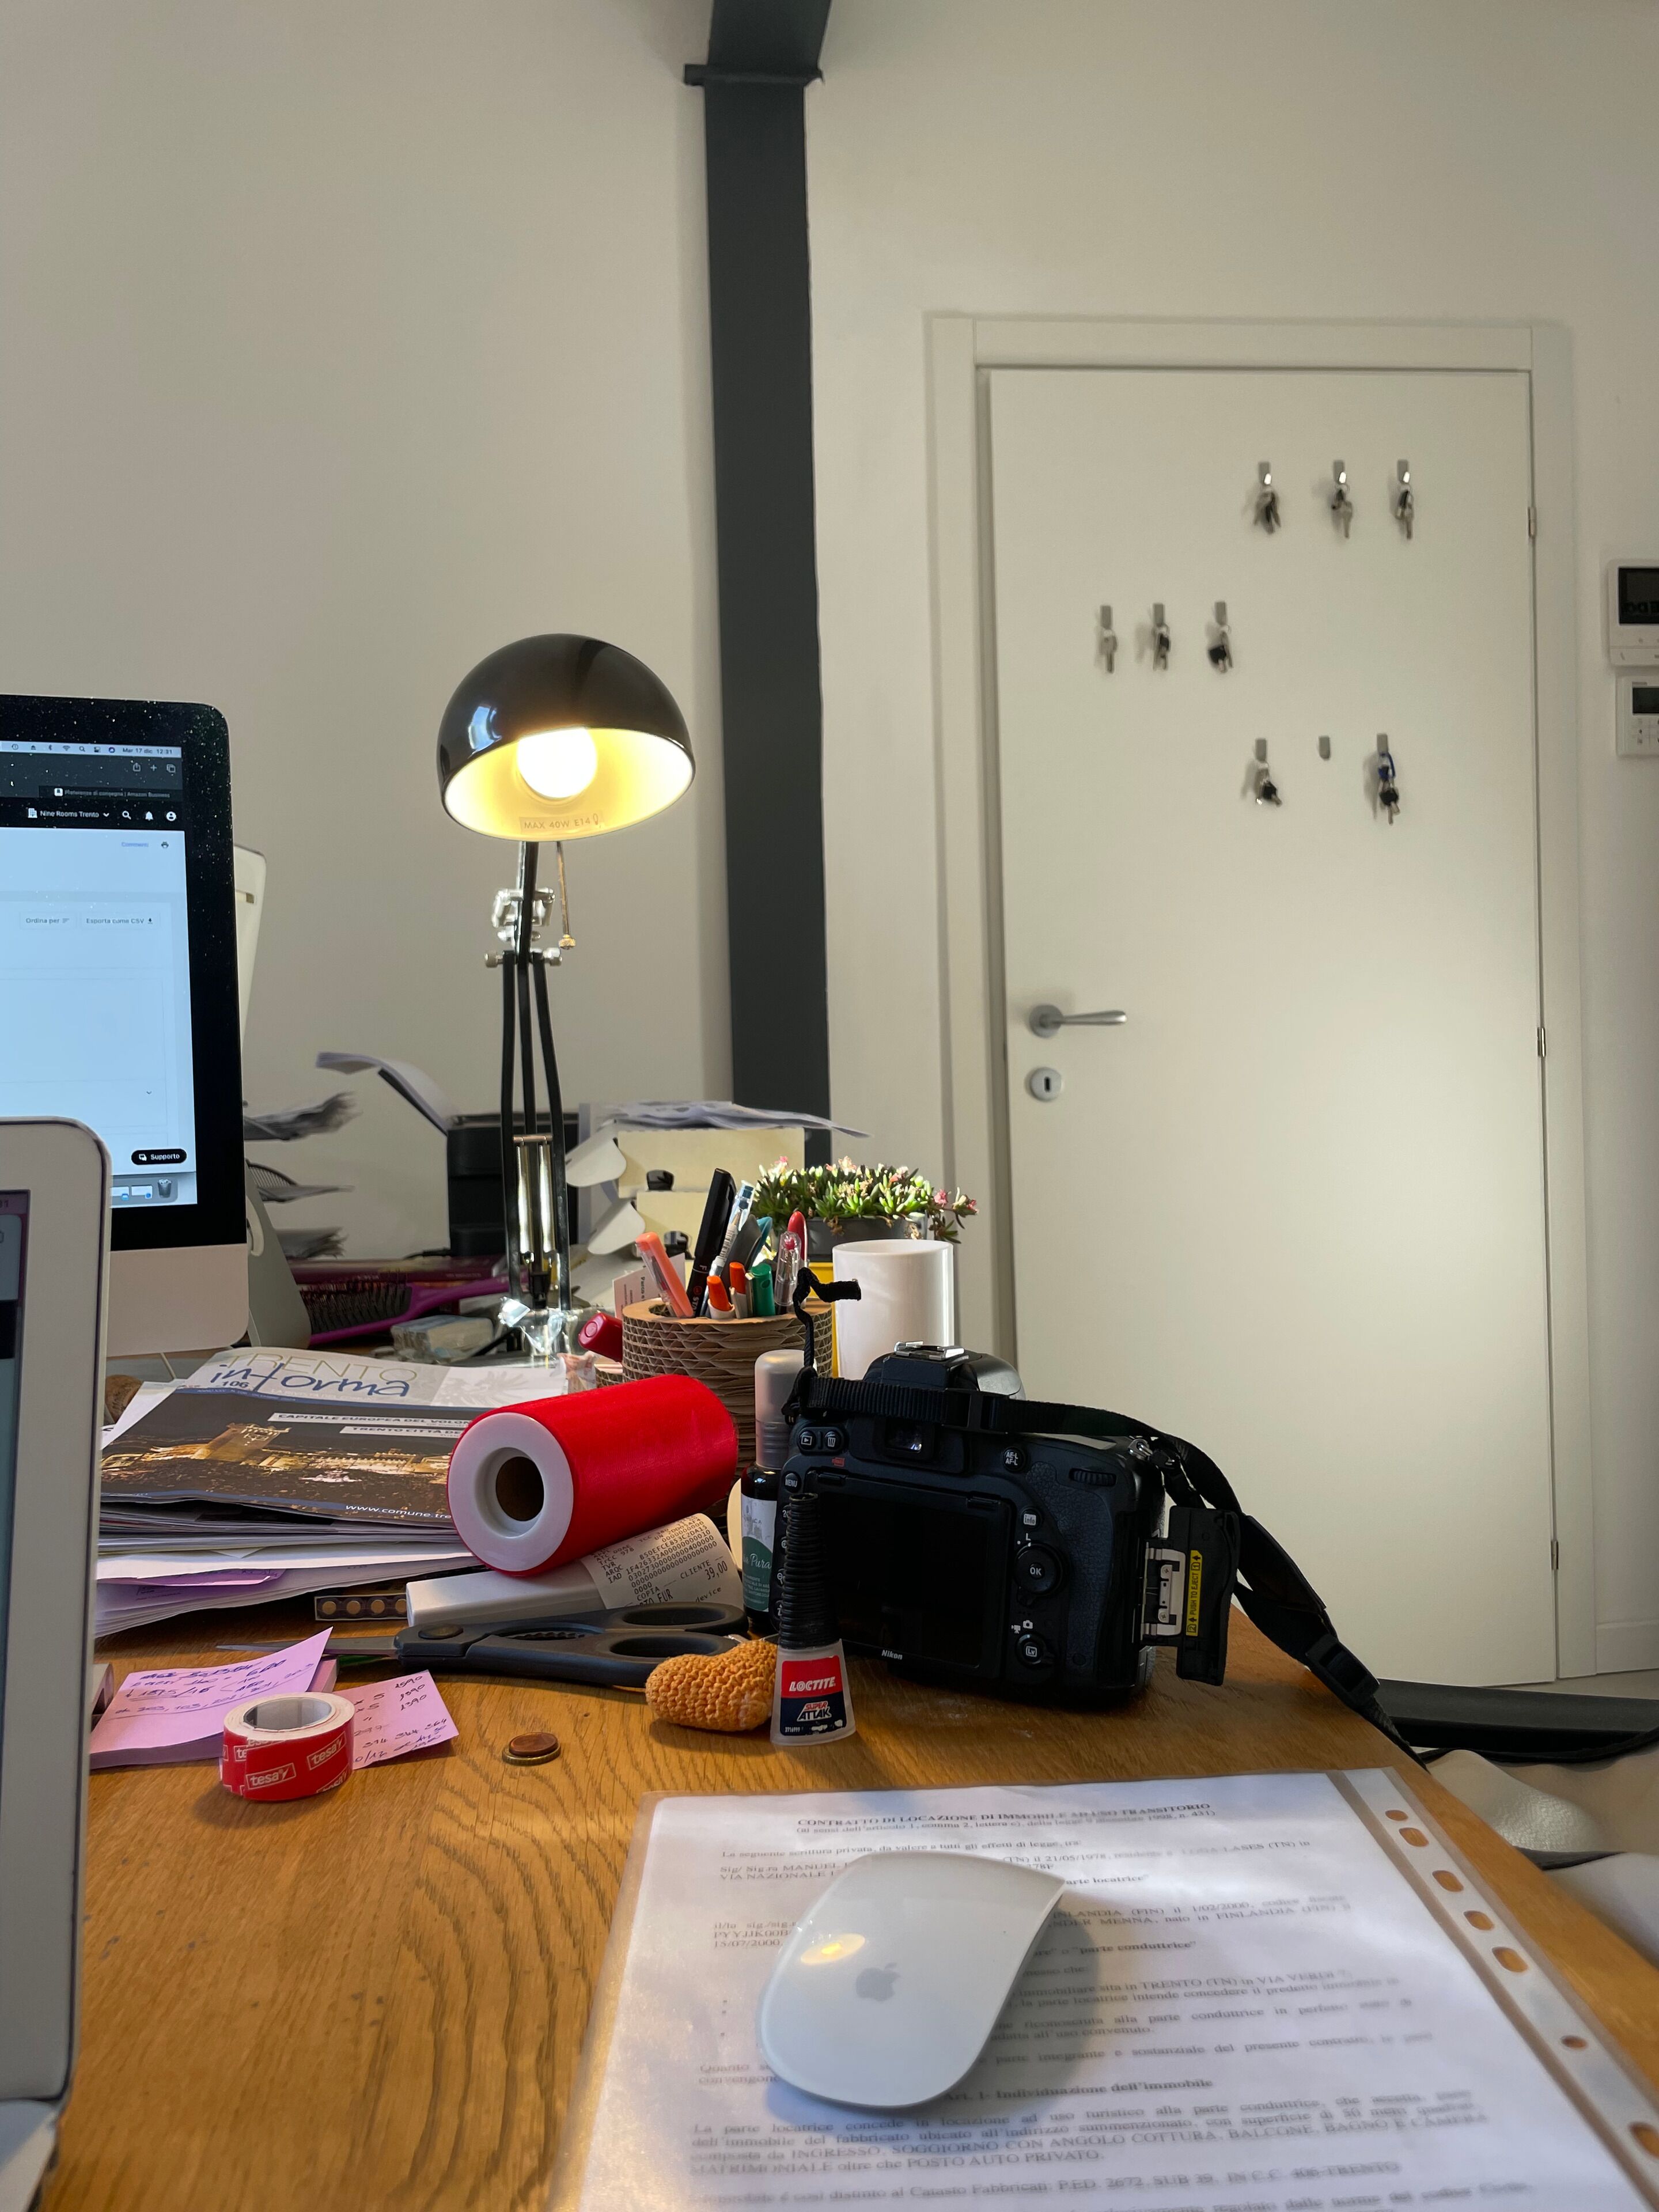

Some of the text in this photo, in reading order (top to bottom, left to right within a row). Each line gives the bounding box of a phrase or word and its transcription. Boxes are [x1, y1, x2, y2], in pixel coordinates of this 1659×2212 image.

[549, 820, 570, 828] 40W
[574, 817, 590, 826] E14
[227, 1353, 417, 1383] TRENTO
[210, 1363, 410, 1397] informa
[785, 1478, 798, 1488] MENU
[346, 1505, 452, 1519] www.comune.tre
[1025, 1533, 1031, 1541] L
[620, 1548, 635, 1556] 978
[602, 1561, 616, 1571] TVR
[750, 1553, 772, 1569] Pura
[605, 1564, 624, 1577] ARQC
[704, 1560, 728, 1581] 39,00
[1029, 1566, 1042, 1576] OK
[608, 1573, 622, 1584] IAD
[636, 1559, 711, 1601] COPIA CLIENTE
[634, 1581, 653, 1594] 0000
[1190, 1590, 1198, 1599] TO
[1190, 1598, 1198, 1615] PUSH
[881, 1649, 903, 1660] Nikon
[789, 1676, 836, 1692] LOCTITE
[805, 1702, 828, 1710] SUPER
[797, 1707, 831, 1721] ATTAK
[310, 1741, 339, 1765] tesa
[249, 1771, 279, 1786] tesa
[798, 1817, 880, 1826] CONTRATTO
[1122, 1803, 1211, 1815] TRANSITORIO
[747, 1871, 825, 1880] NAZIONALE
[1140, 1978, 1203, 1990] TRENTO
[1206, 1978, 1238, 1987] (TN)
[1256, 1975, 1285, 1985] VIA
[1132, 1991, 1180, 2002] intende
[1183, 1988, 1249, 1998] concedere
[1113, 2014, 1138, 2024] alla
[1147, 2013, 1181, 2025] parte
[1274, 2006, 1288, 2015] in
[1214, 2043, 1235, 2054] del
[845, 2119, 904, 2131] concede
[891, 2134, 1126, 2155] SOGGIORNO CON ANGOLO
[907, 2156, 965, 2168] POSTO
[968, 2153, 1021, 2166] AUTO
